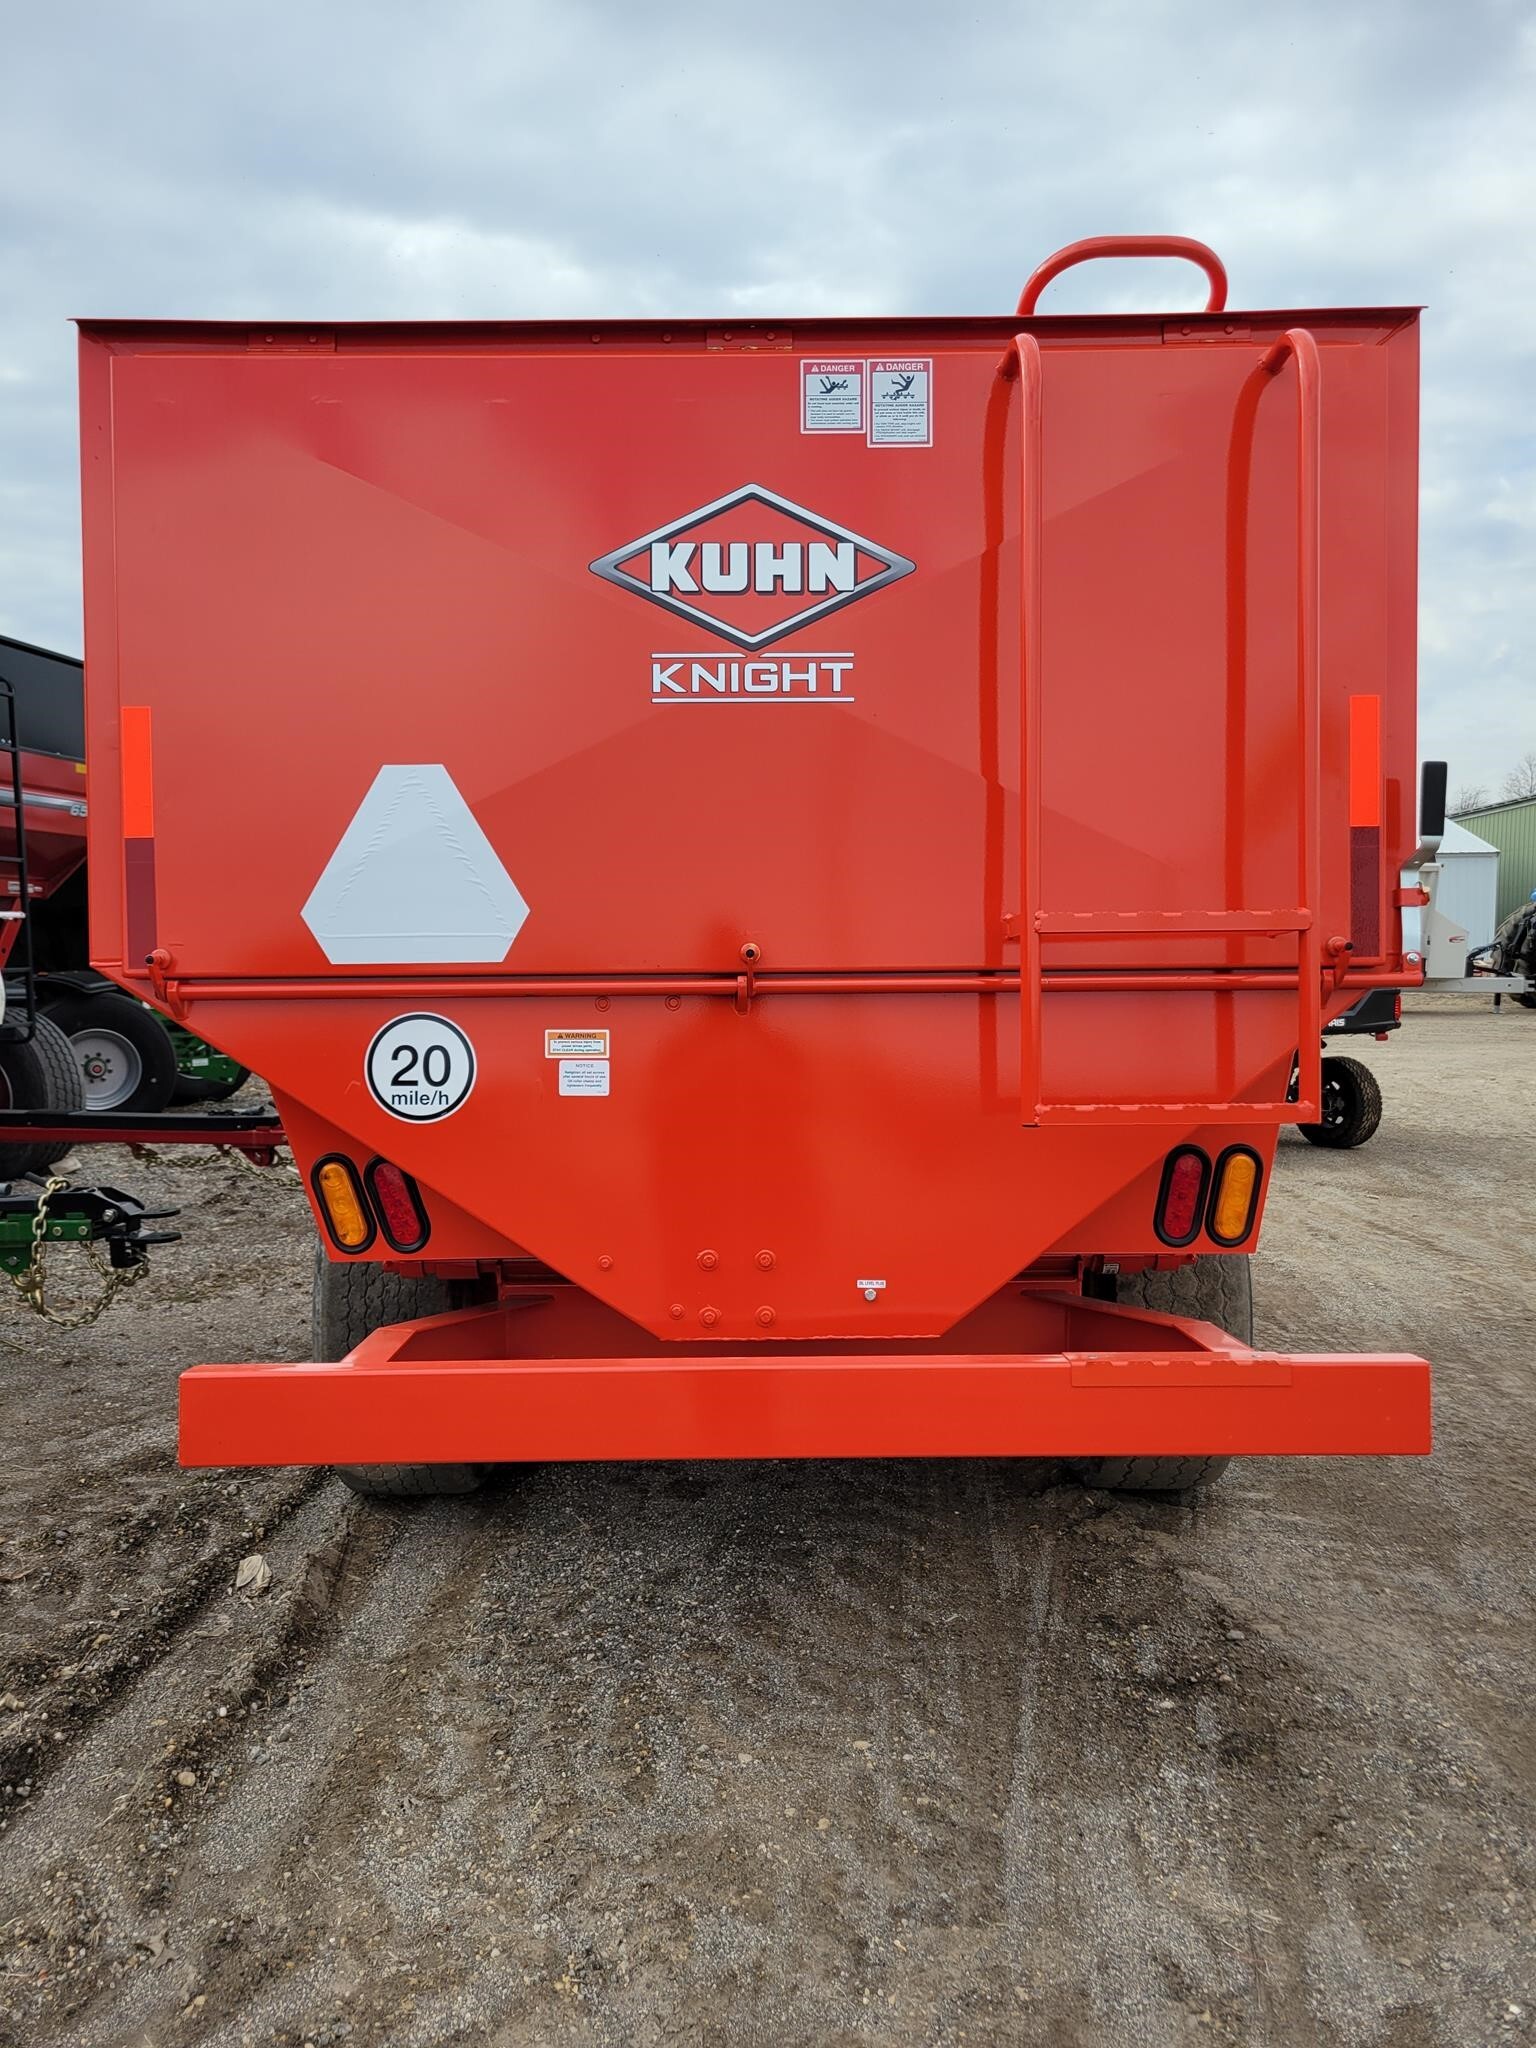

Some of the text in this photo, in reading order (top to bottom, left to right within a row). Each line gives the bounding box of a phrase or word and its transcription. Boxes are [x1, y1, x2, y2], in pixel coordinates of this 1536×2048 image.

[820, 364, 855, 372] DANGER
[886, 362, 924, 371] DANGER
[651, 542, 856, 594] KUHN
[652, 662, 854, 693] KNIGHT
[390, 1044, 451, 1088] 20
[391, 1090, 449, 1106] mile/h
